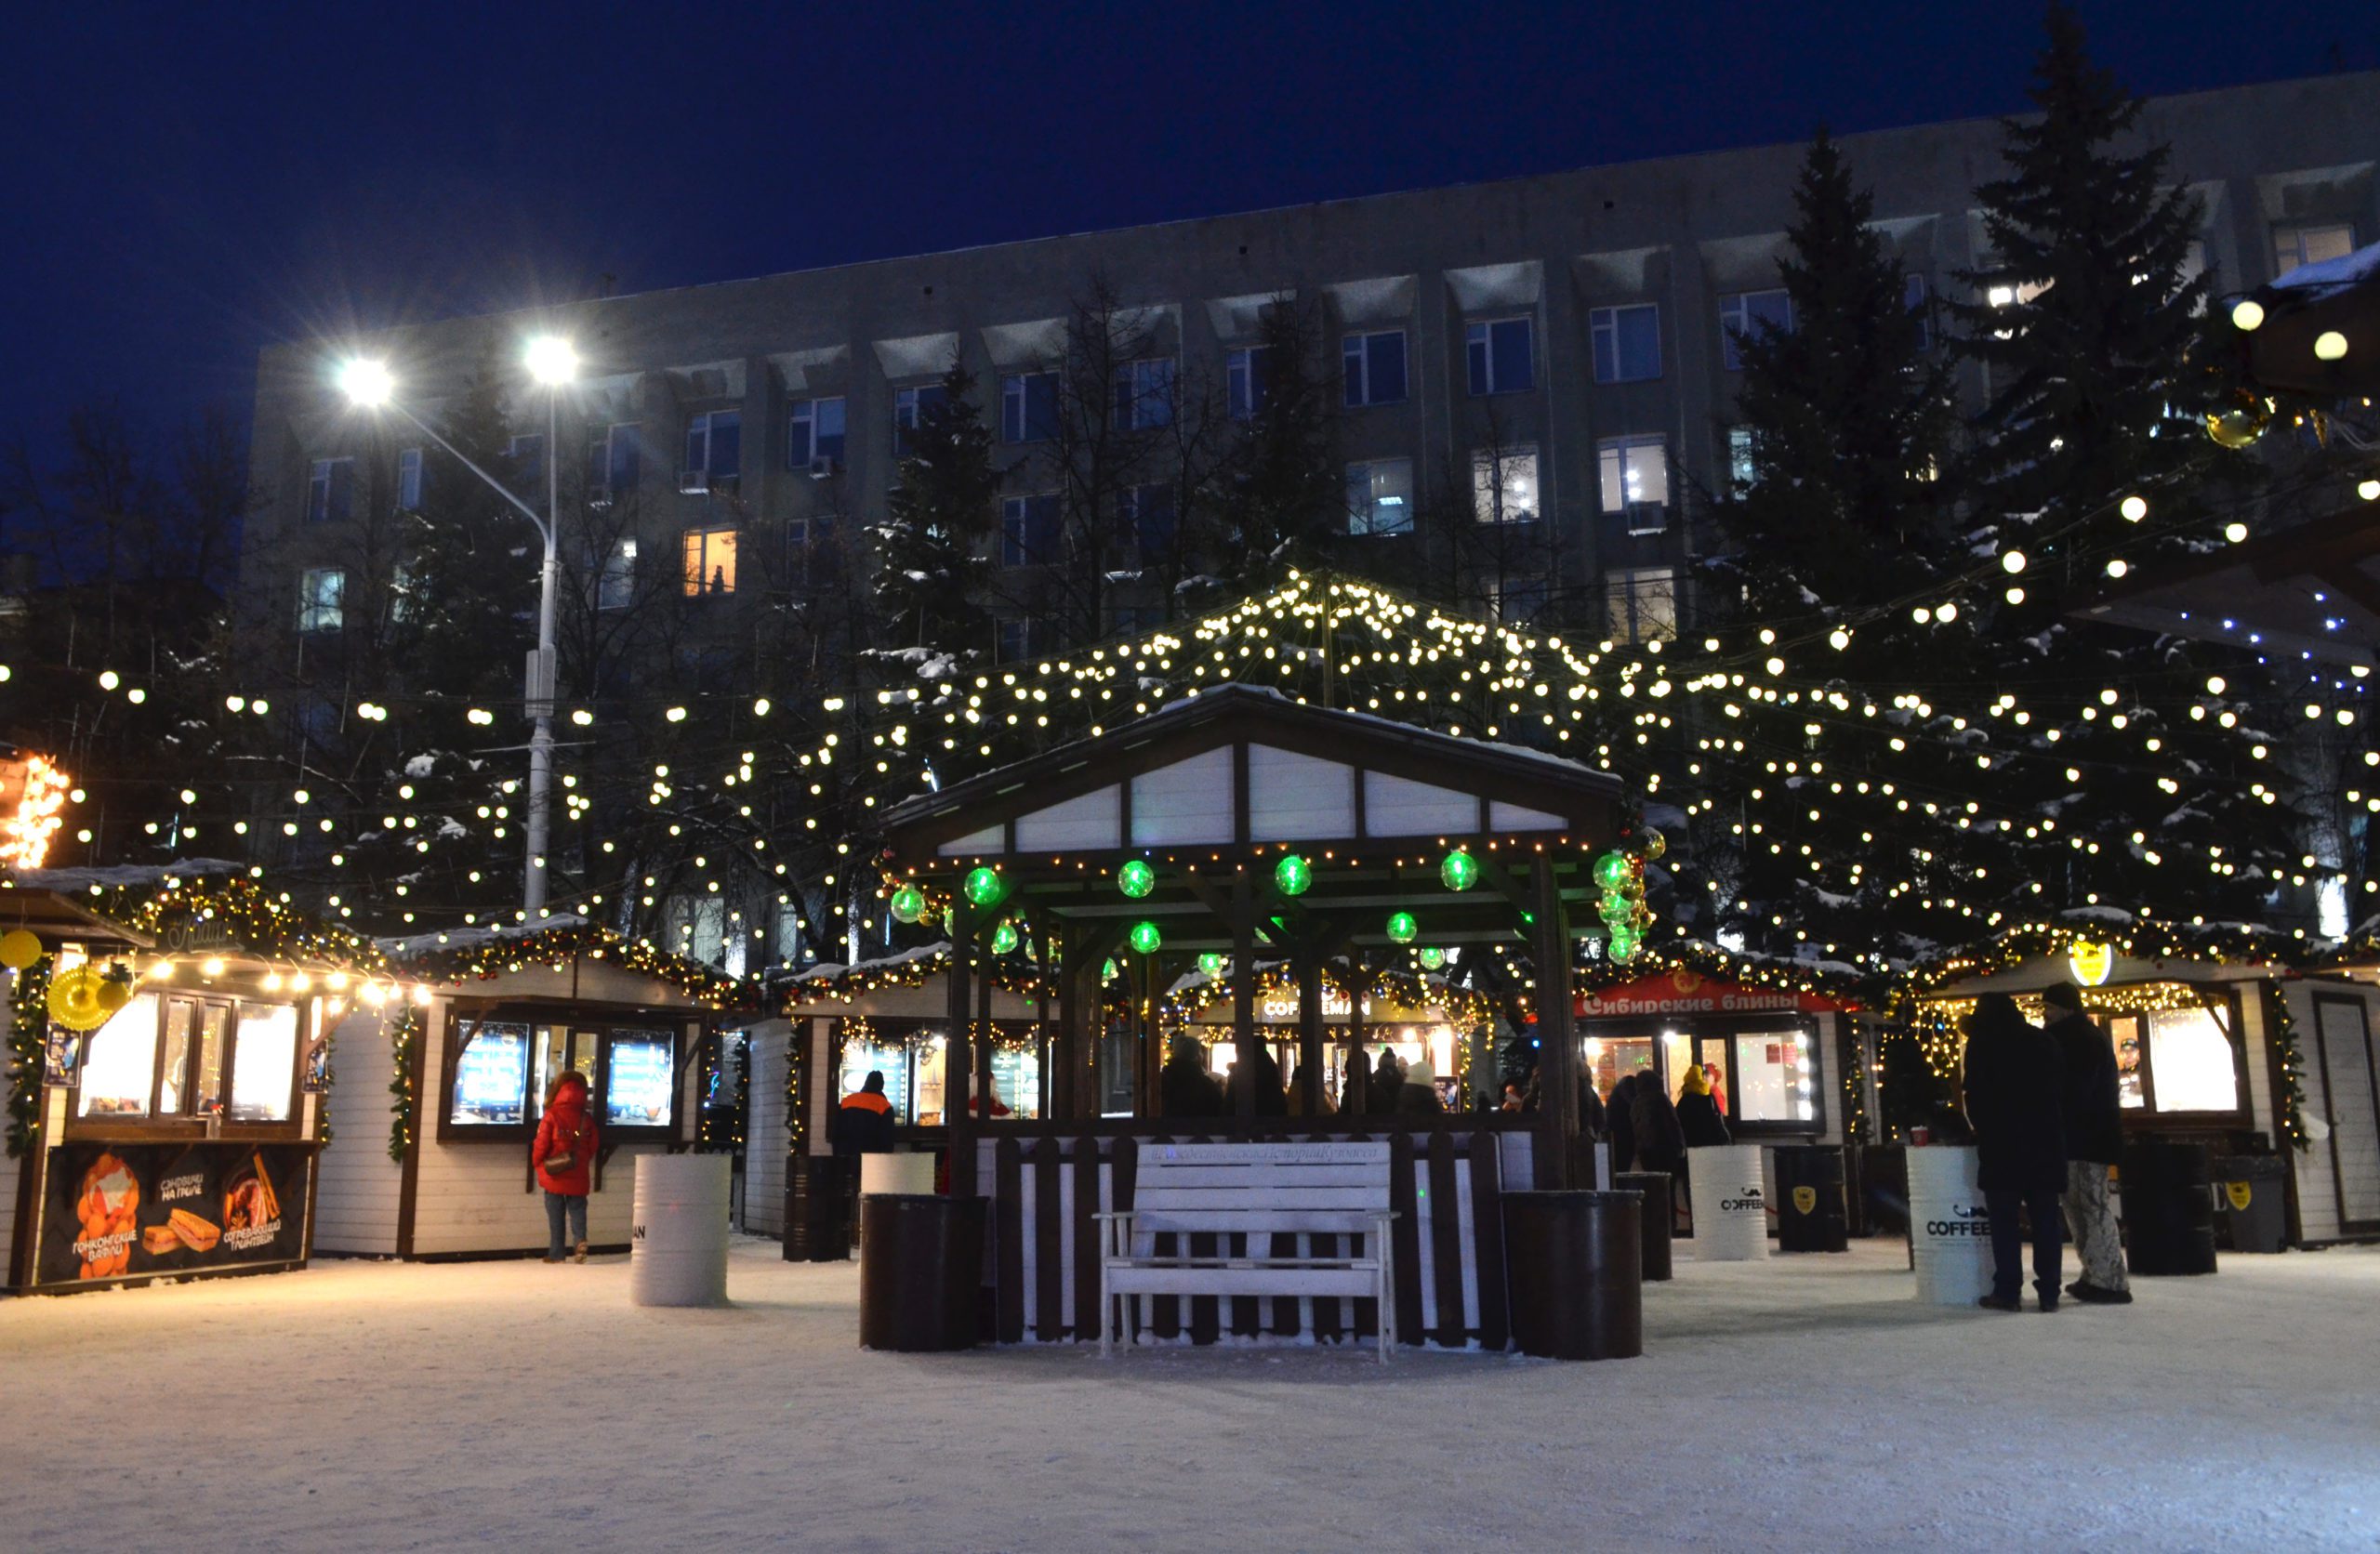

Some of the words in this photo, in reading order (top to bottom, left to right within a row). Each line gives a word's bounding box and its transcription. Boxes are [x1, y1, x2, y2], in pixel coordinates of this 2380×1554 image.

[1263, 1001, 1371, 1016] COFEMAN
[1582, 995, 1714, 1015] Сибирские
[1722, 994, 1800, 1010] блины
[162, 1189, 176, 1201] НА
[177, 1184, 203, 1198] ГРИЛЕ
[73, 1230, 138, 1254] ГОНКОНГСКИЕ
